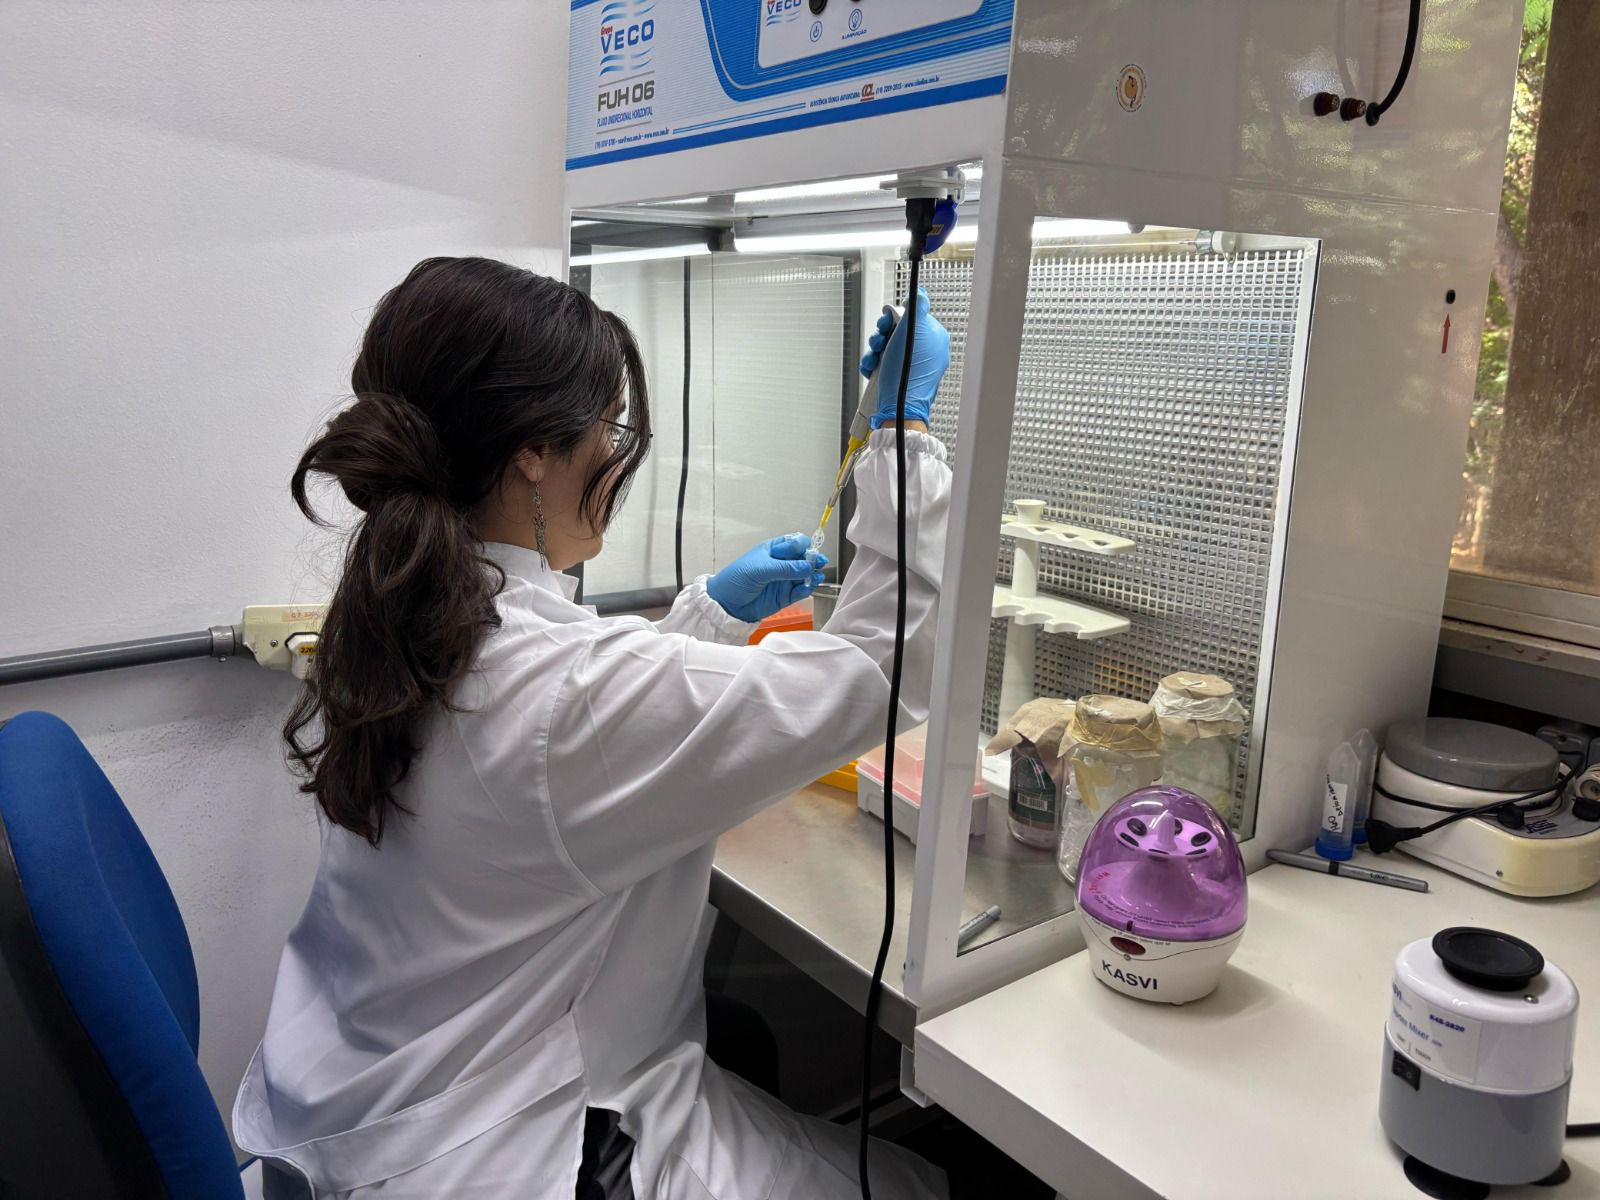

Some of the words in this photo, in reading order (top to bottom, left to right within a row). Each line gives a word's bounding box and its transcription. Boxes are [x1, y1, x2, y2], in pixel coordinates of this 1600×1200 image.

[601, 19, 655, 54] VECO
[598, 86, 630, 112] FUH
[632, 80, 655, 103] 06
[1102, 960, 1158, 990] KASVI
[1409, 1021, 1430, 1041] Mixer
